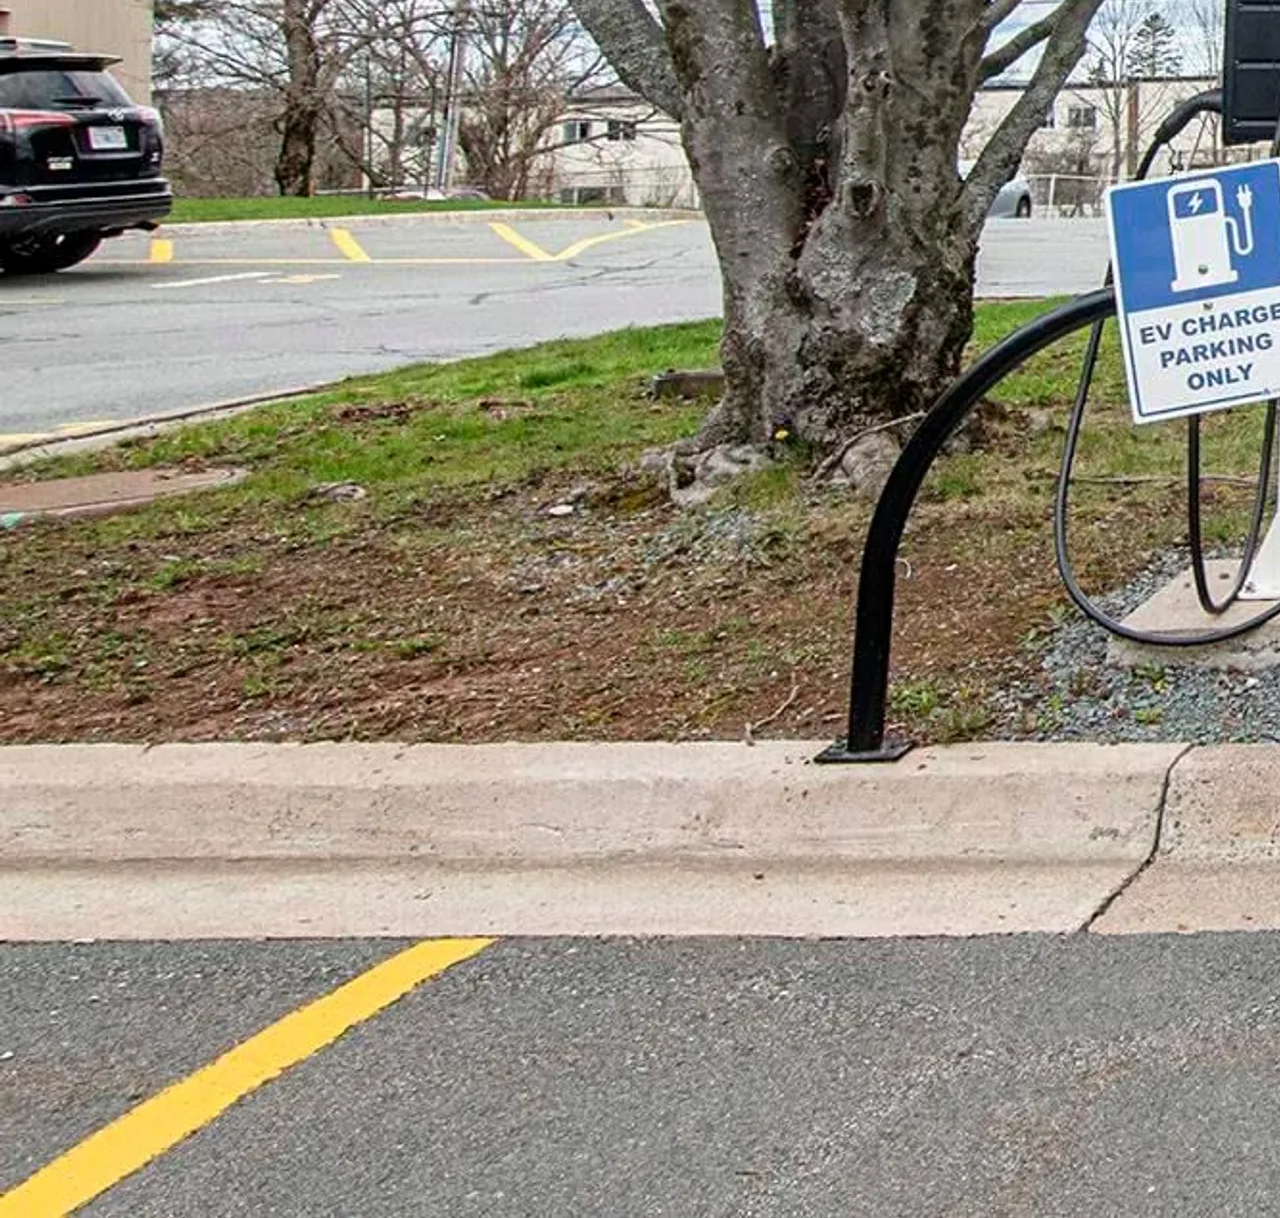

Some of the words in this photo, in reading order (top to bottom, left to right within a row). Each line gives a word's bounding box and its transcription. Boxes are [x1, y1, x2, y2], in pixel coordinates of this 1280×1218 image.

[1139, 323, 1172, 345] EV
[1160, 333, 1273, 368] PARKING
[1187, 363, 1254, 391] ONLY
